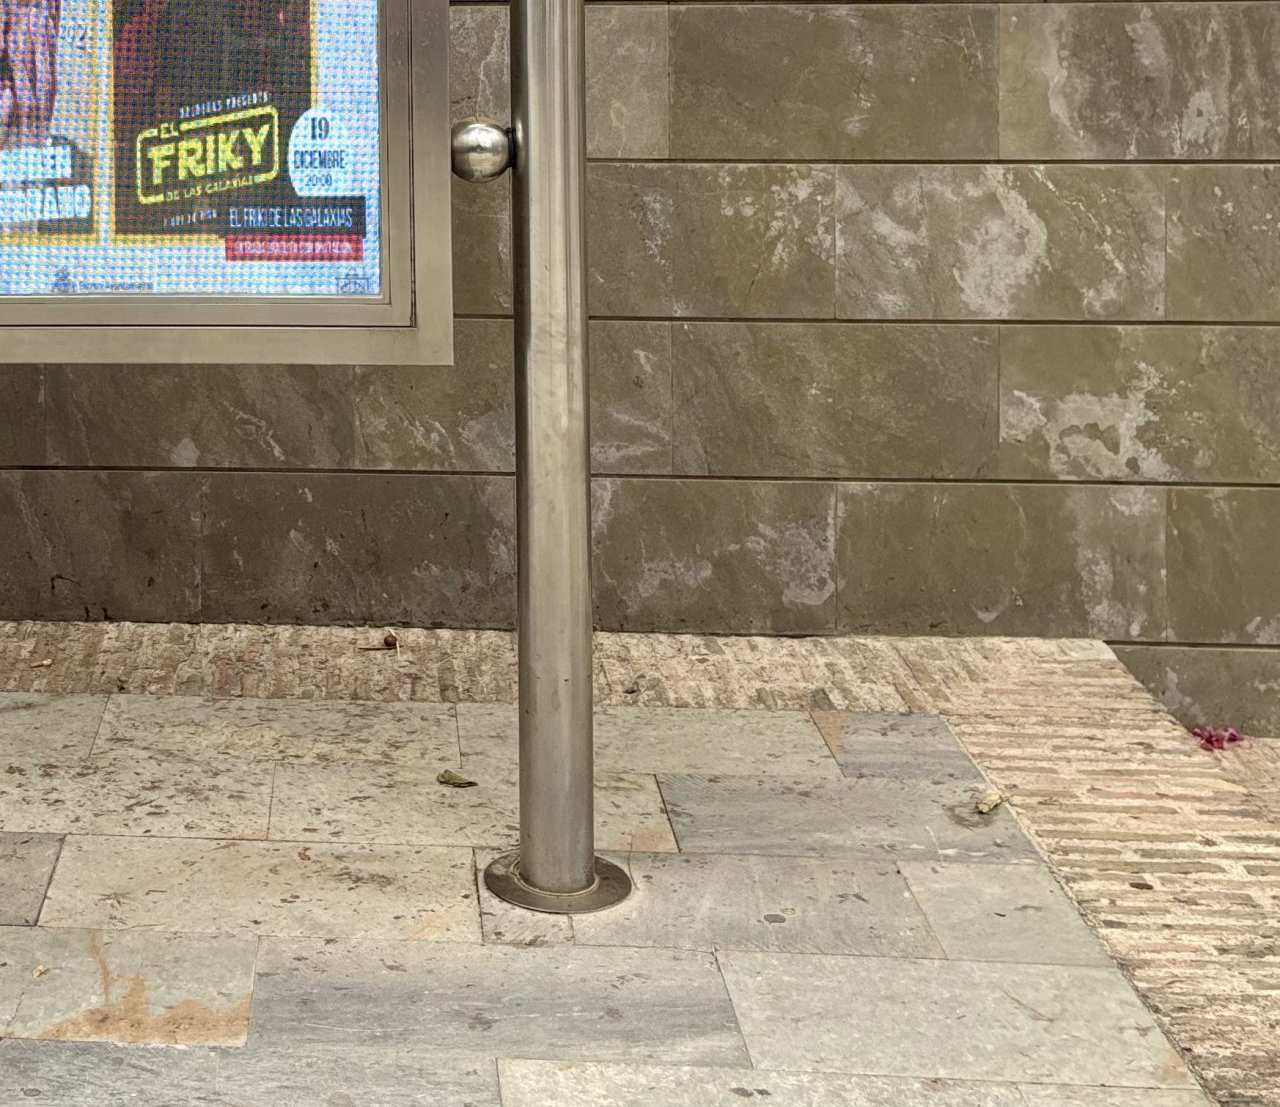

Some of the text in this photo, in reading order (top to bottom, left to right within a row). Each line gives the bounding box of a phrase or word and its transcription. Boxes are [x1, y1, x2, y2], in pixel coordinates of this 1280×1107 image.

[160, 122, 179, 139] EL
[310, 116, 330, 141] 19
[147, 124, 271, 185] FRIKY
[293, 149, 346, 170] DICIEMBRE
[229, 207, 241, 227] EL
[269, 207, 282, 227] DE
[284, 207, 302, 227] LAS
[304, 207, 353, 227] GALAXIAS
